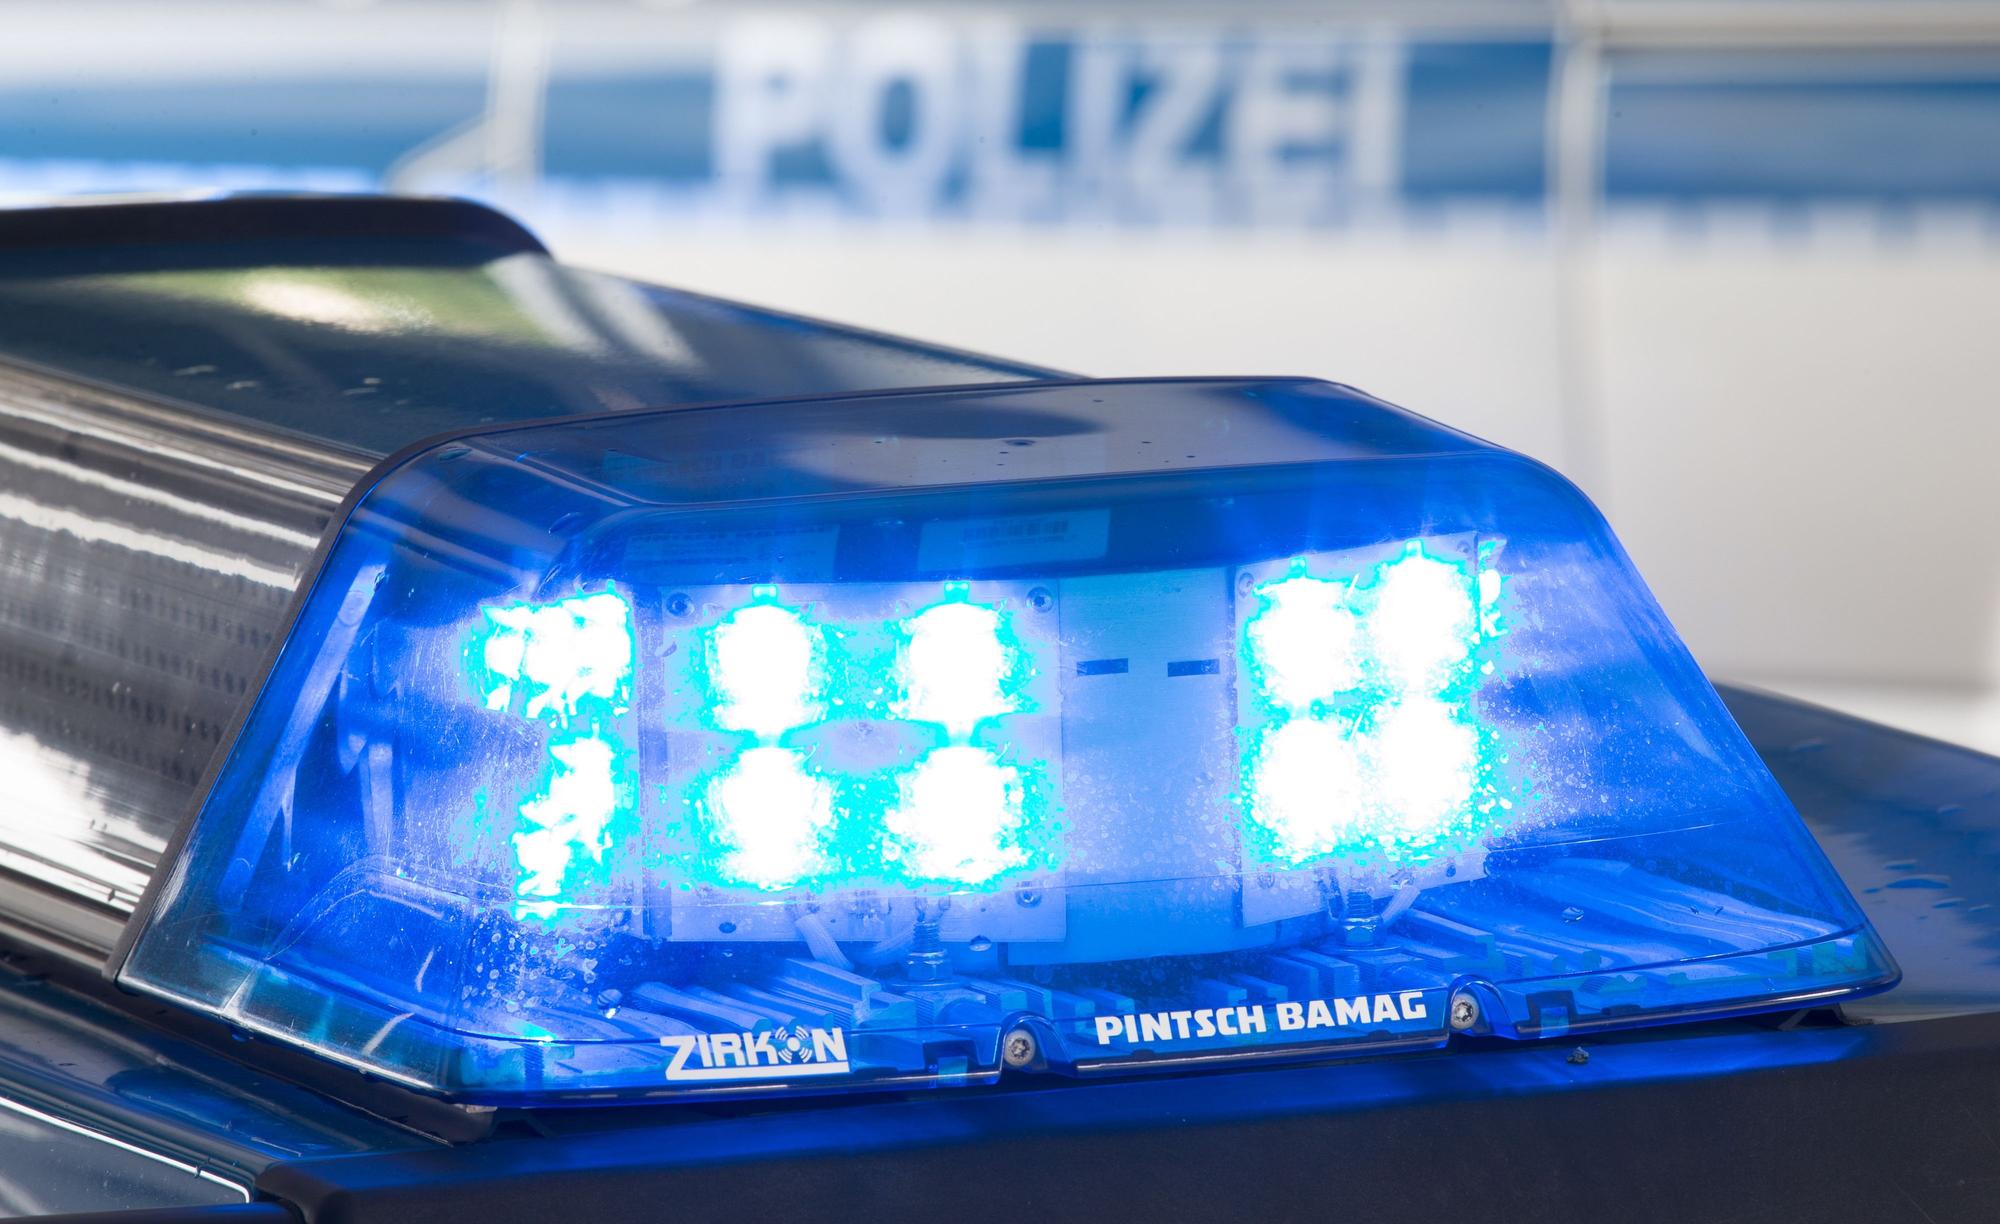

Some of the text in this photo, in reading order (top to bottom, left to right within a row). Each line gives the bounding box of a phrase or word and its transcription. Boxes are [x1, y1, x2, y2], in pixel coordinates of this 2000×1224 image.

[710, 20, 1408, 208] POLIZEI
[1095, 991, 1427, 1045] PINTSCH BAMAG
[660, 1025, 850, 1081] ZIRKON
